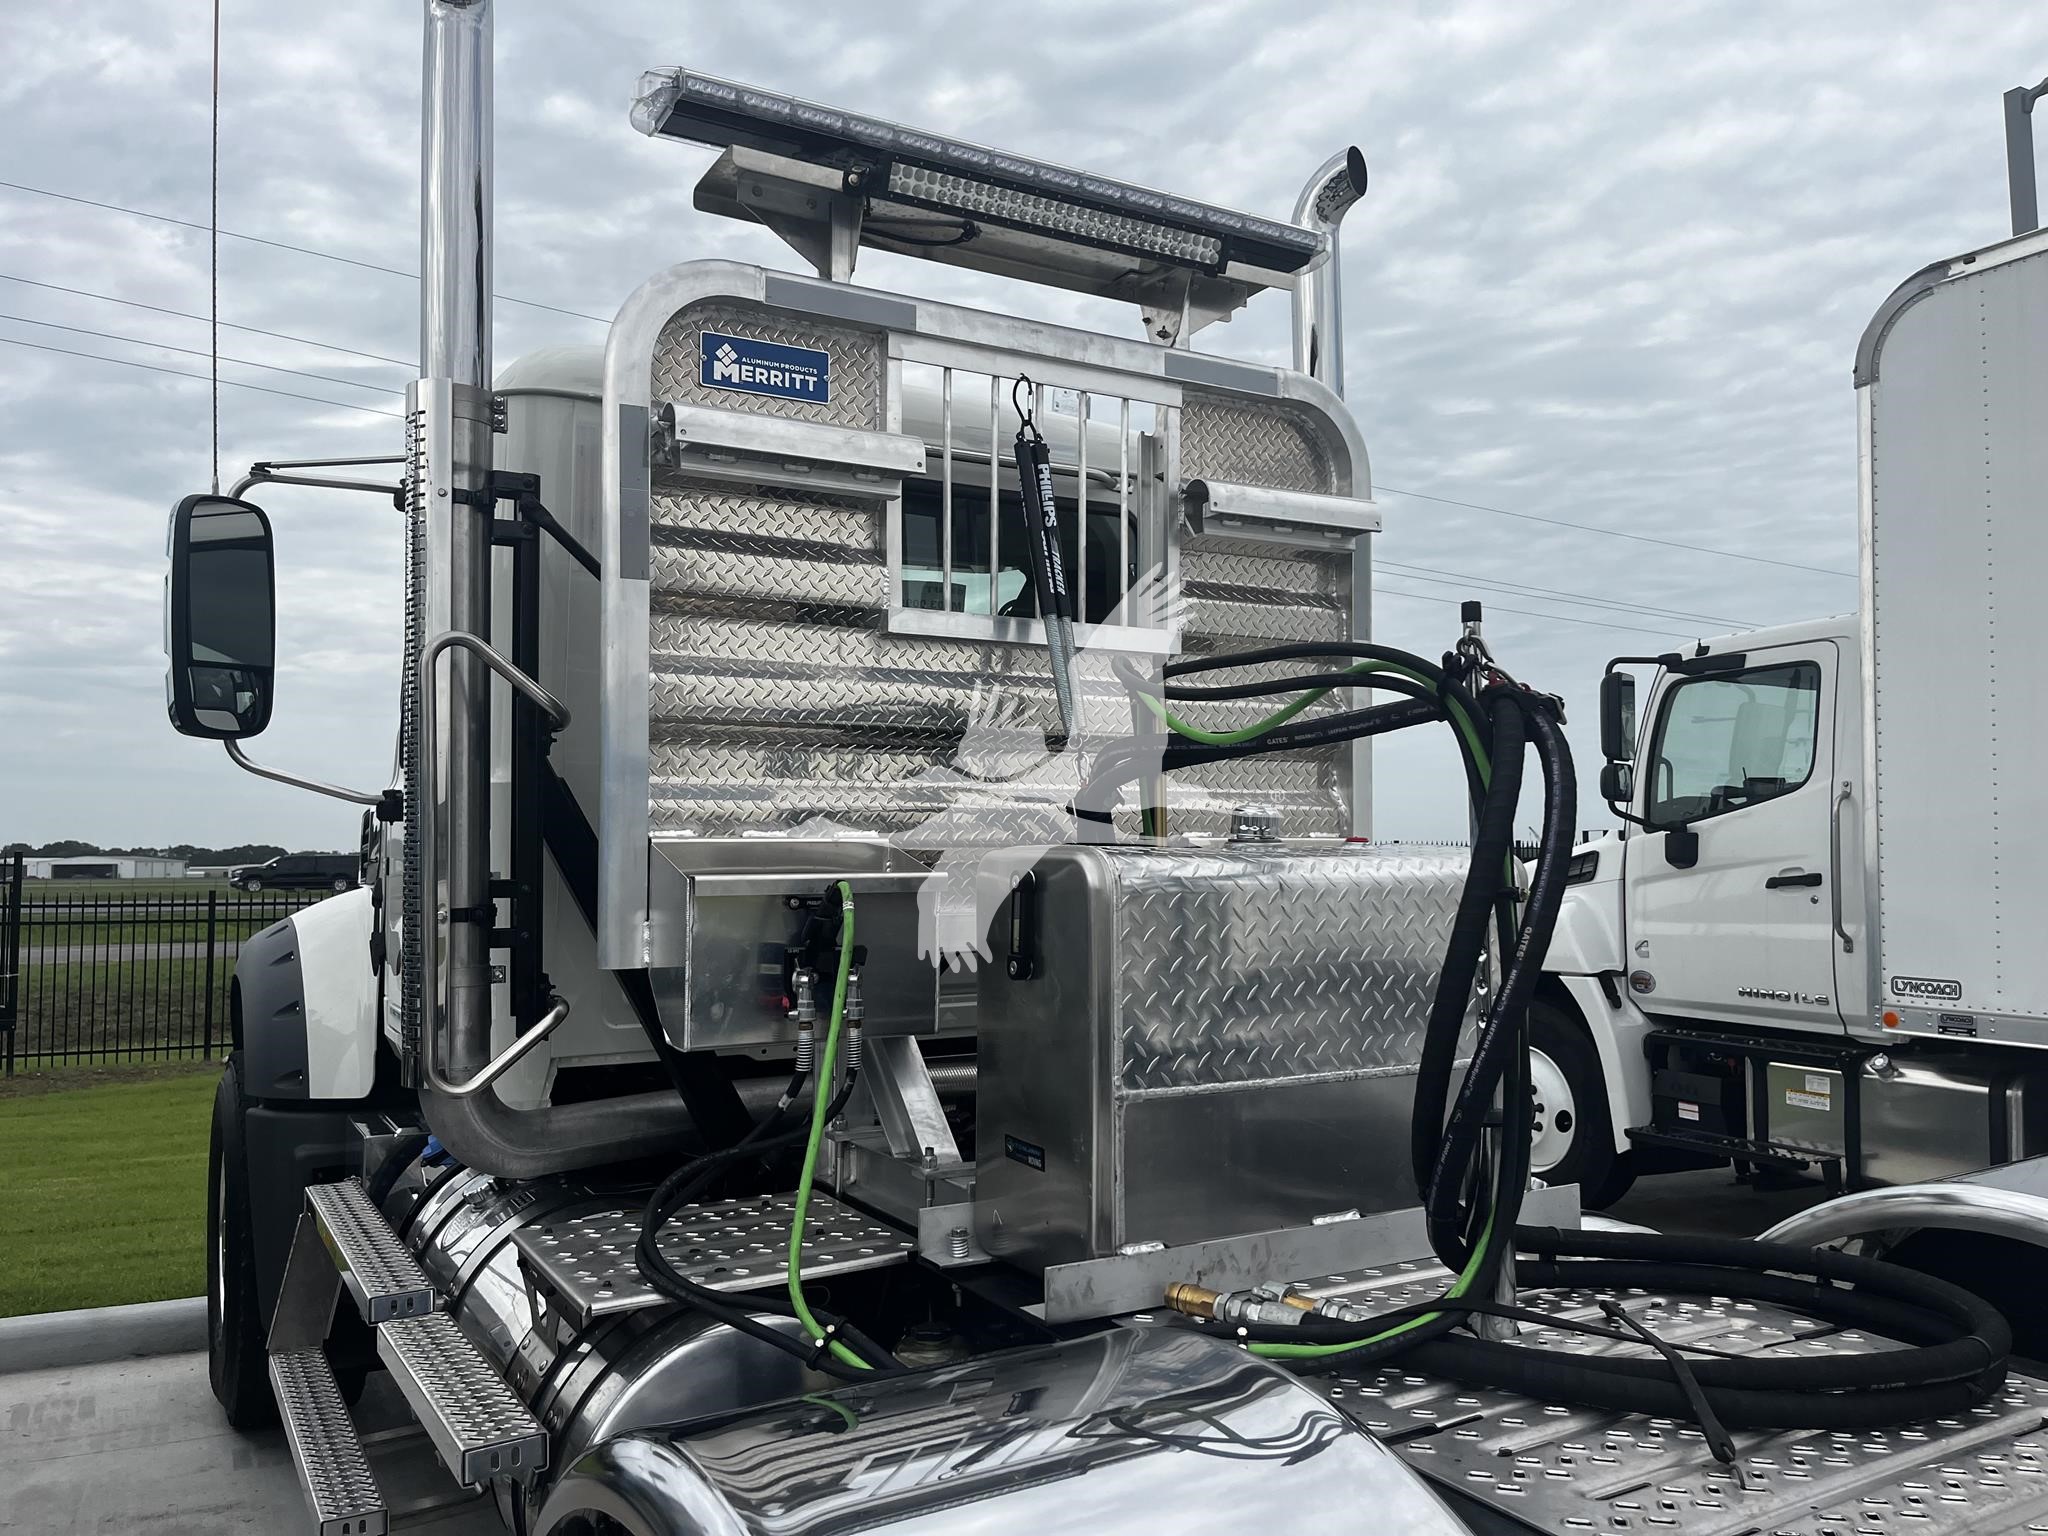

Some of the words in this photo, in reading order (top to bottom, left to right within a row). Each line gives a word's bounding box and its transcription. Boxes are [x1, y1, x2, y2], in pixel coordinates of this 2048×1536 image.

[713, 360, 818, 392] MERRITT
[741, 357, 780, 368] ALUMINUM
[781, 363, 818, 375] PRODUCTS
[1037, 463, 1057, 528] PHILLIPS
[1052, 551, 1066, 596] TRACKER
[1266, 737, 1288, 745] GATES
[1516, 926, 1533, 958] GATES
[1738, 987, 1791, 1002] HINO
[1894, 980, 1958, 996] LYNCOACH
